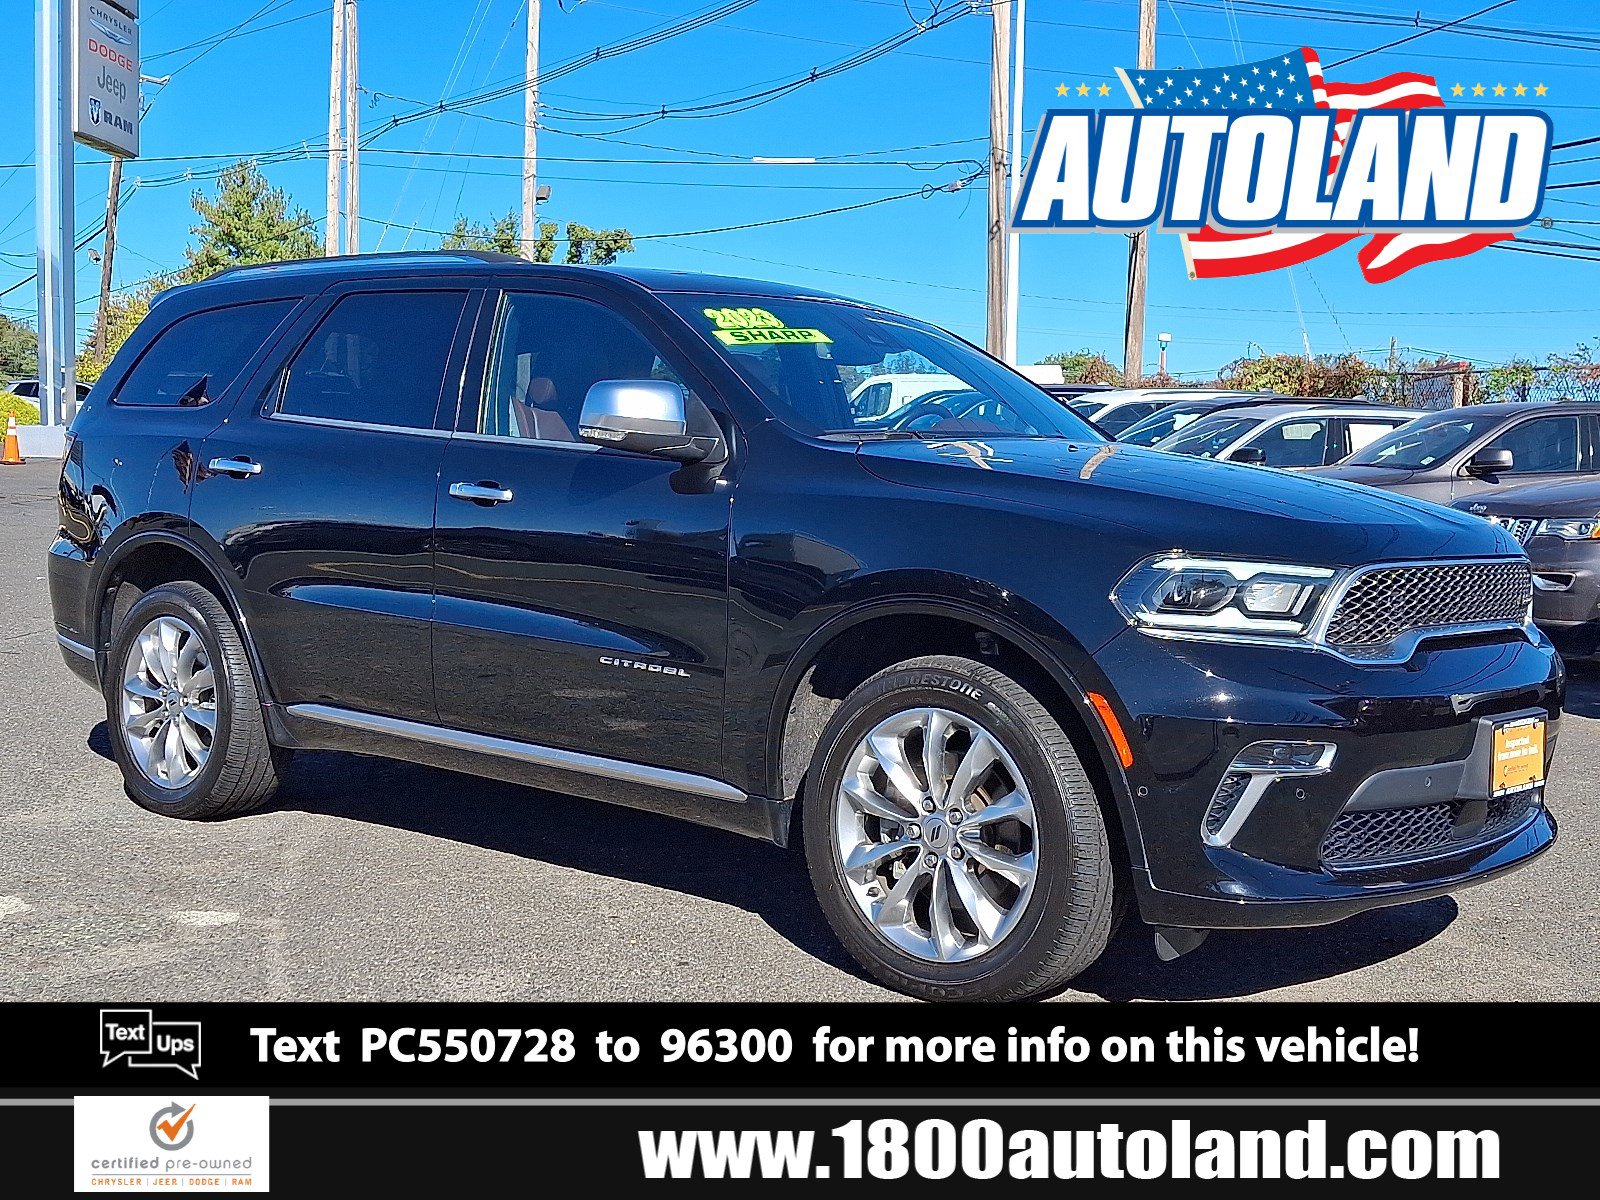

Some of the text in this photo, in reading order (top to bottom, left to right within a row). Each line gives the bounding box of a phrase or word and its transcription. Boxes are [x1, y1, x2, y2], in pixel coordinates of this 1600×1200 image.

[89, 5, 132, 35] CHRYSLER
[88, 38, 133, 72] DODGE
[97, 65, 126, 103] Jeep
[103, 109, 134, 135] RAM
[703, 307, 786, 329] 2023
[729, 330, 815, 342] SHARP
[599, 656, 691, 678] CITADEL
